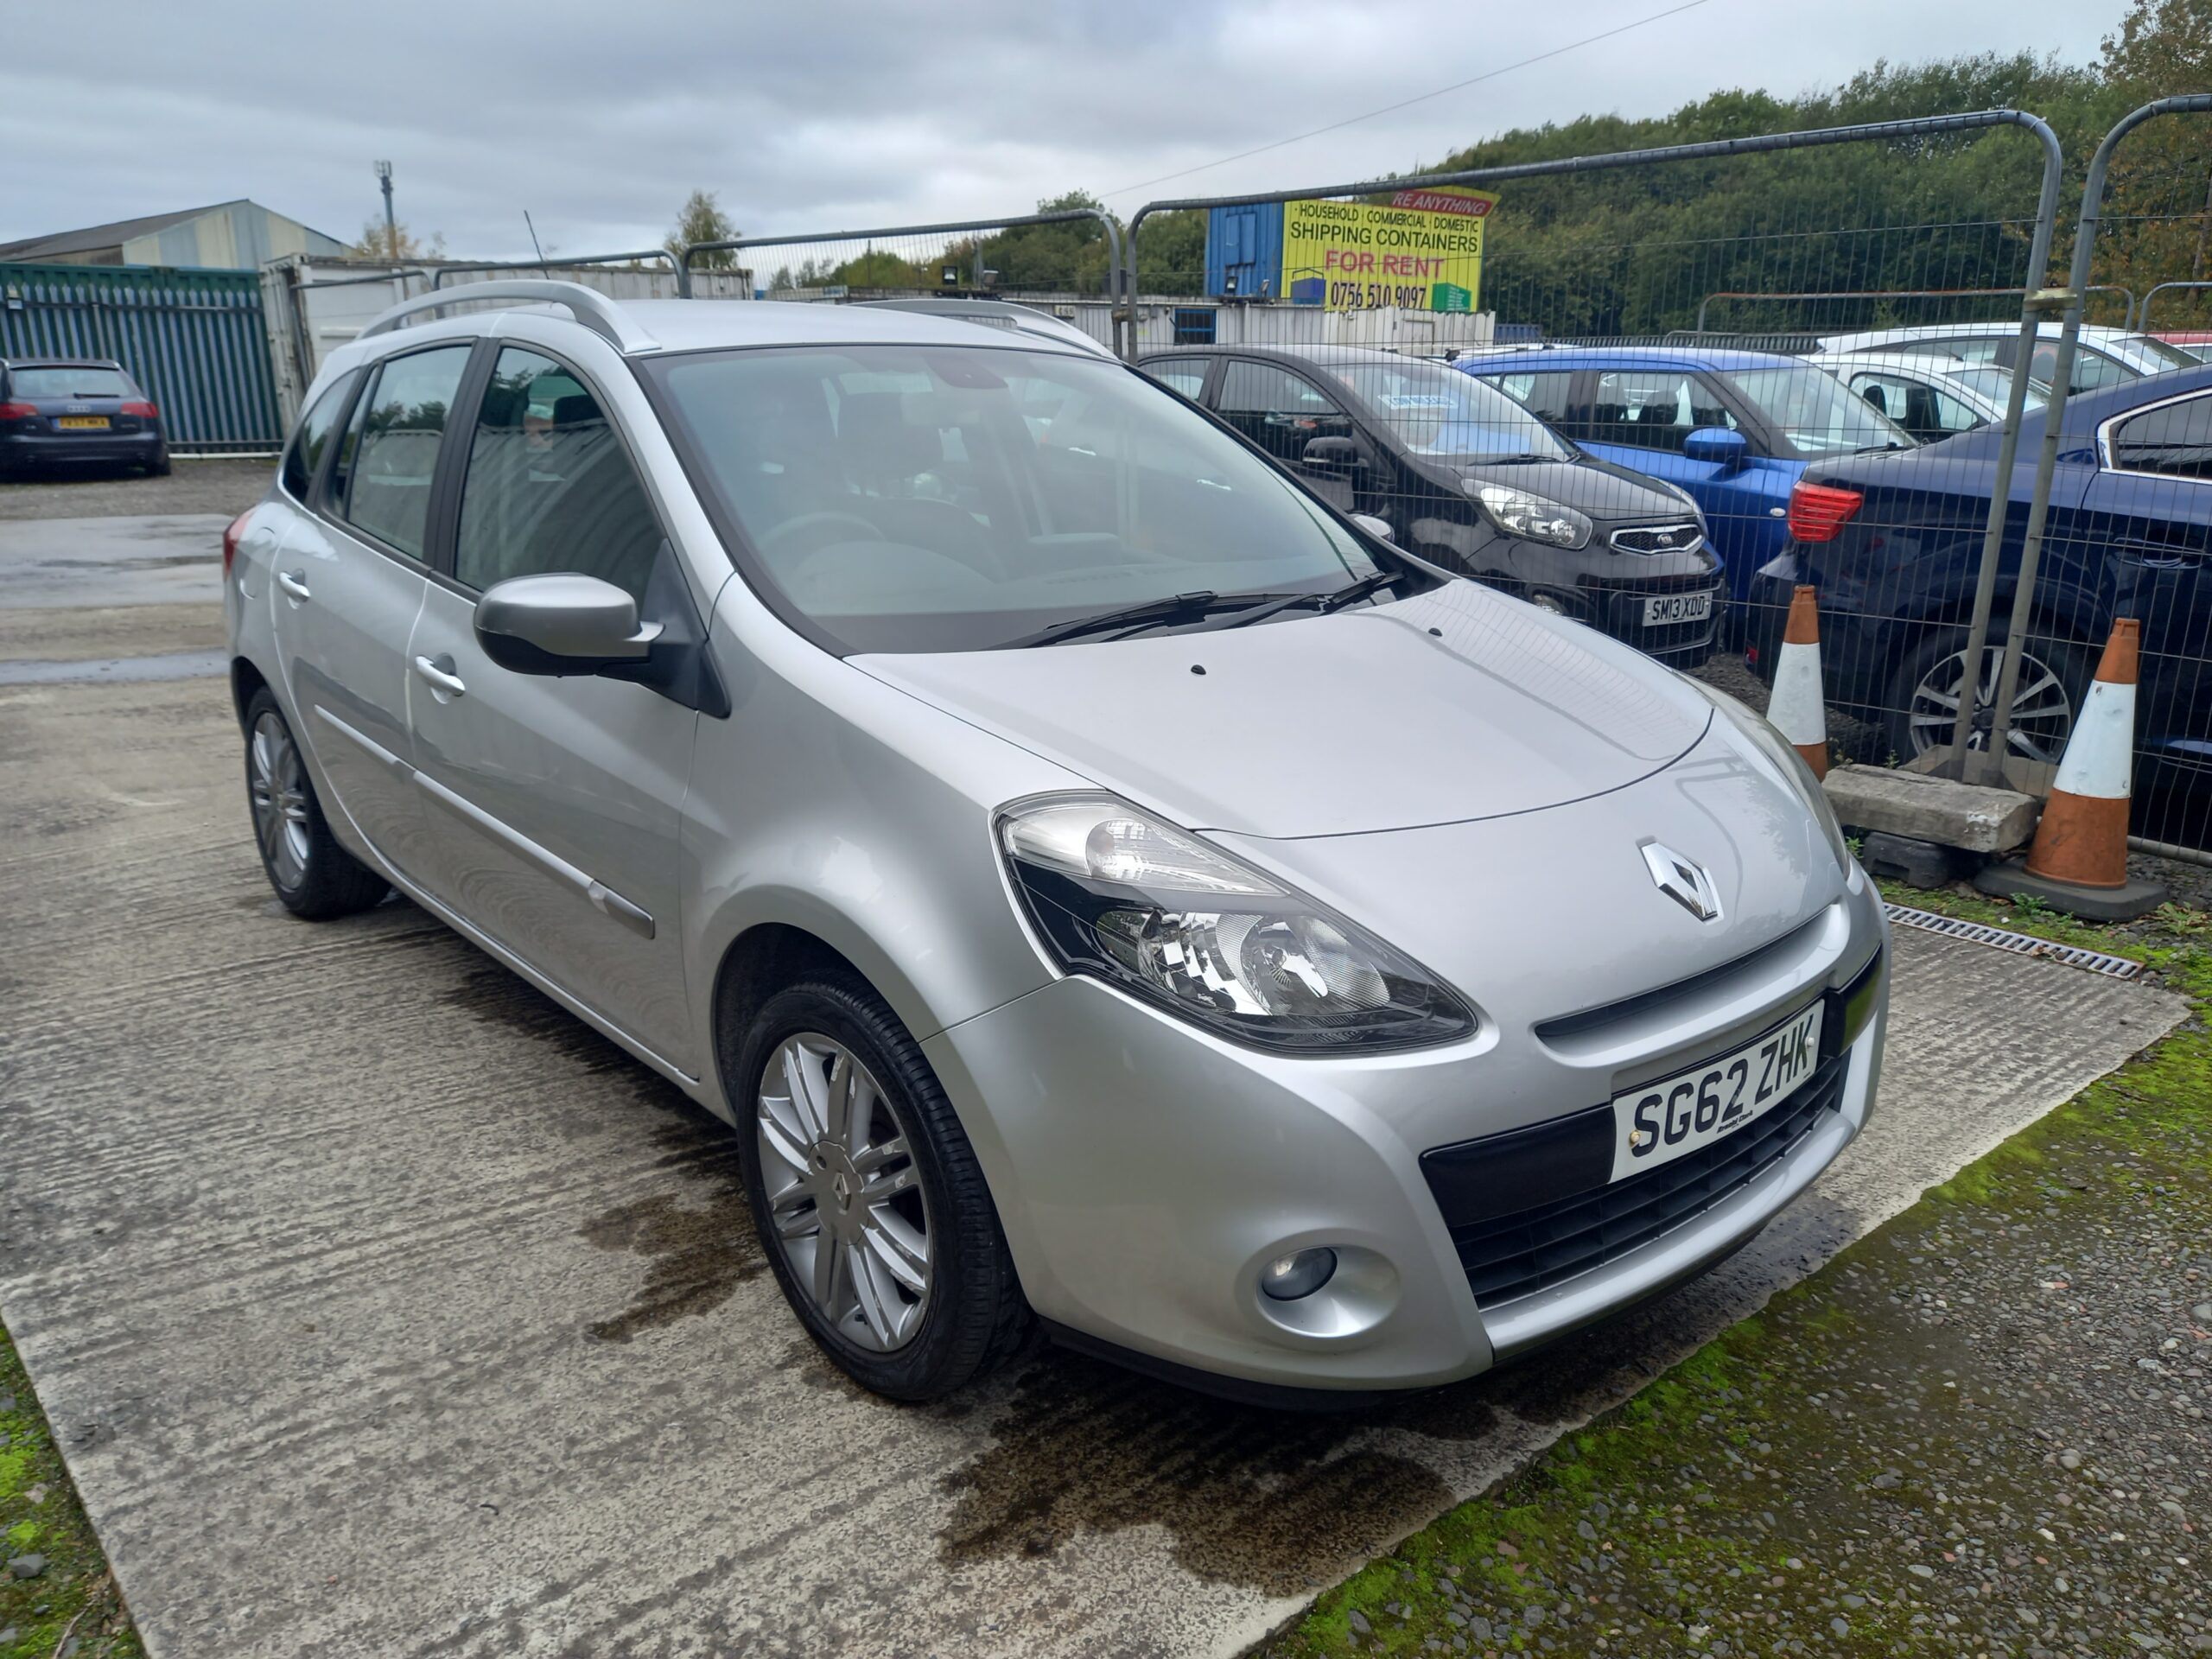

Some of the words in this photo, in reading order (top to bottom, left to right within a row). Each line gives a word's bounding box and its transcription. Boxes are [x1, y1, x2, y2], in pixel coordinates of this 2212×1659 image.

[1300, 204, 1358, 221] HOUSEHOLD
[1367, 210, 1426, 228] COMMERCIAL
[1434, 216, 1478, 232] DOMESTIC
[1414, 194, 1485, 214] ANYTHING
[1291, 221, 1371, 245] SHIPPING
[1376, 228, 1478, 253] CONTAINERS
[1325, 250, 1376, 274] FOR
[1382, 254, 1445, 279] RENT
[1331, 282, 1363, 308] 0756
[1368, 284, 1391, 308] 510
[1395, 286, 1427, 309] 9097
[1651, 599, 1681, 620] SM13
[1631, 1058, 1748, 1158] SG62
[1755, 1014, 1814, 1104] ZHK
